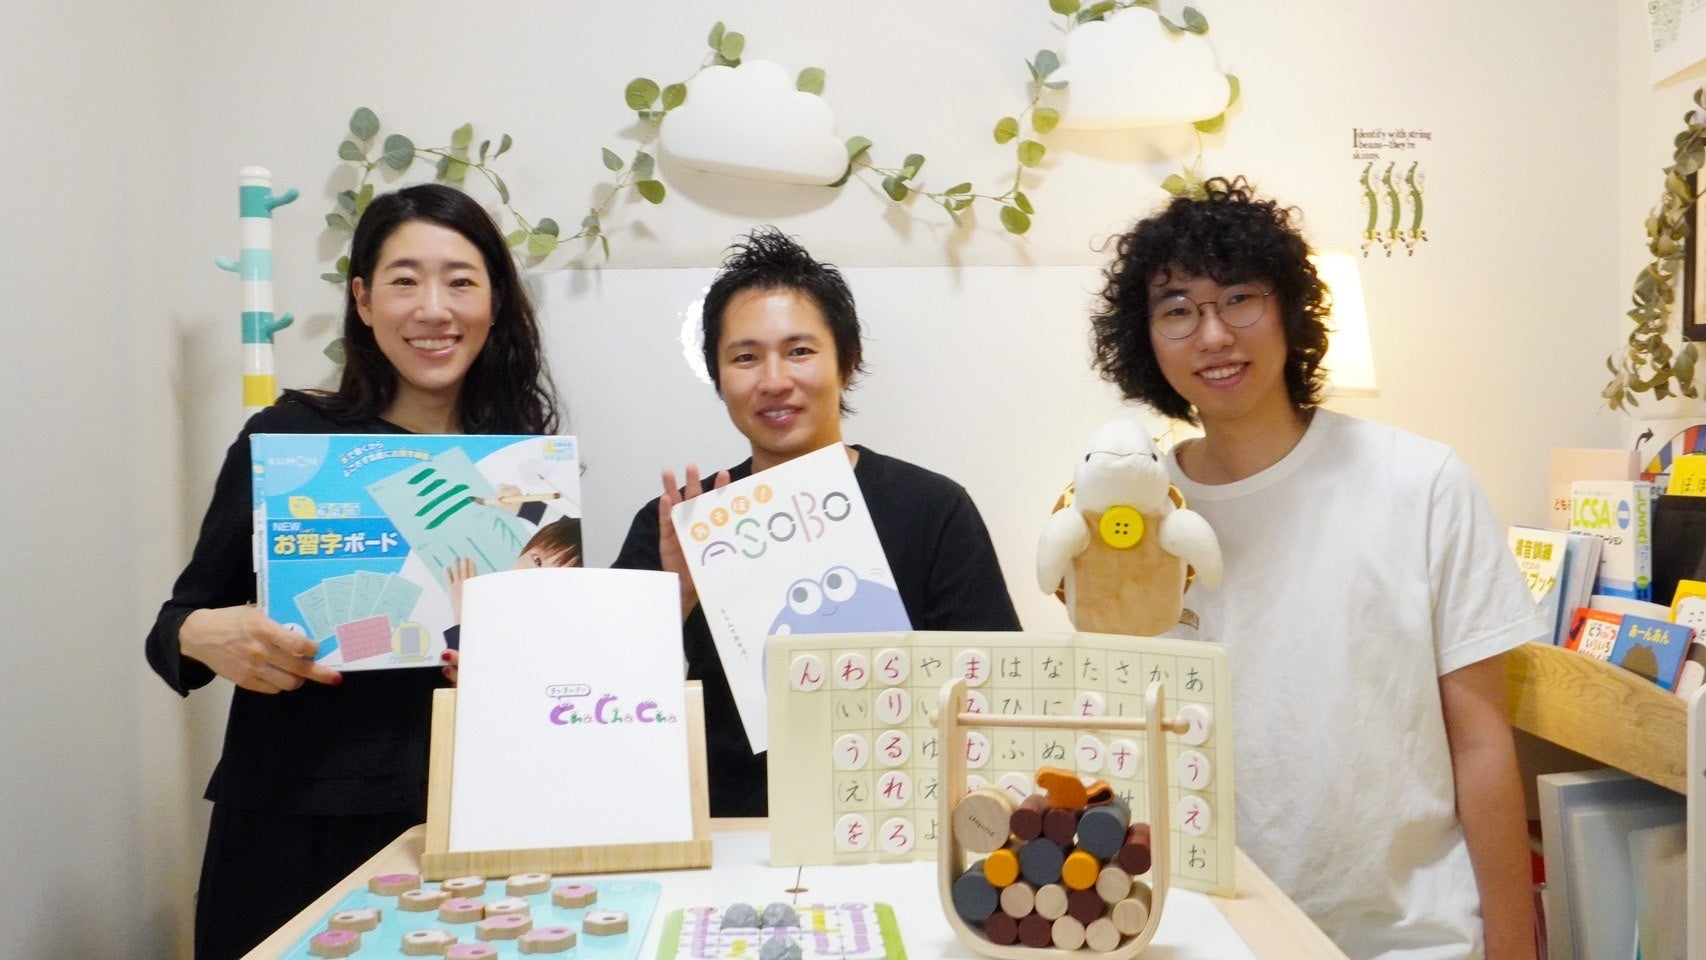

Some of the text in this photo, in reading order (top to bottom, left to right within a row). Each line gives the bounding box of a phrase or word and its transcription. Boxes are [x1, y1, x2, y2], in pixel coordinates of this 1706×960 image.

[1352, 128, 1432, 148] Identify with string
[272, 522, 302, 532] NEW
[1573, 496, 1612, 529] LCSA
[273, 532, 399, 555] お習字ボード
[800, 662, 820, 685] ん
[842, 659, 864, 681] わ
[884, 657, 899, 678] ら
[920, 658, 941, 677] や
[965, 657, 981, 679] ま
[1001, 657, 1022, 678] は
[1042, 656, 1063, 679] な
[1083, 657, 1098, 681] た
[1115, 661, 1130, 684] さ
[1185, 667, 1204, 692] あ
[889, 694, 901, 716] り
[885, 737, 902, 759] る
[1002, 740, 1024, 760] ふ
[1042, 740, 1065, 761] ぬ
[1112, 747, 1131, 771] す
[883, 777, 904, 800] れ
[1185, 810, 1201, 830] え
[848, 821, 863, 845] を
[889, 825, 907, 847] ろ
[1188, 845, 1207, 869] お
